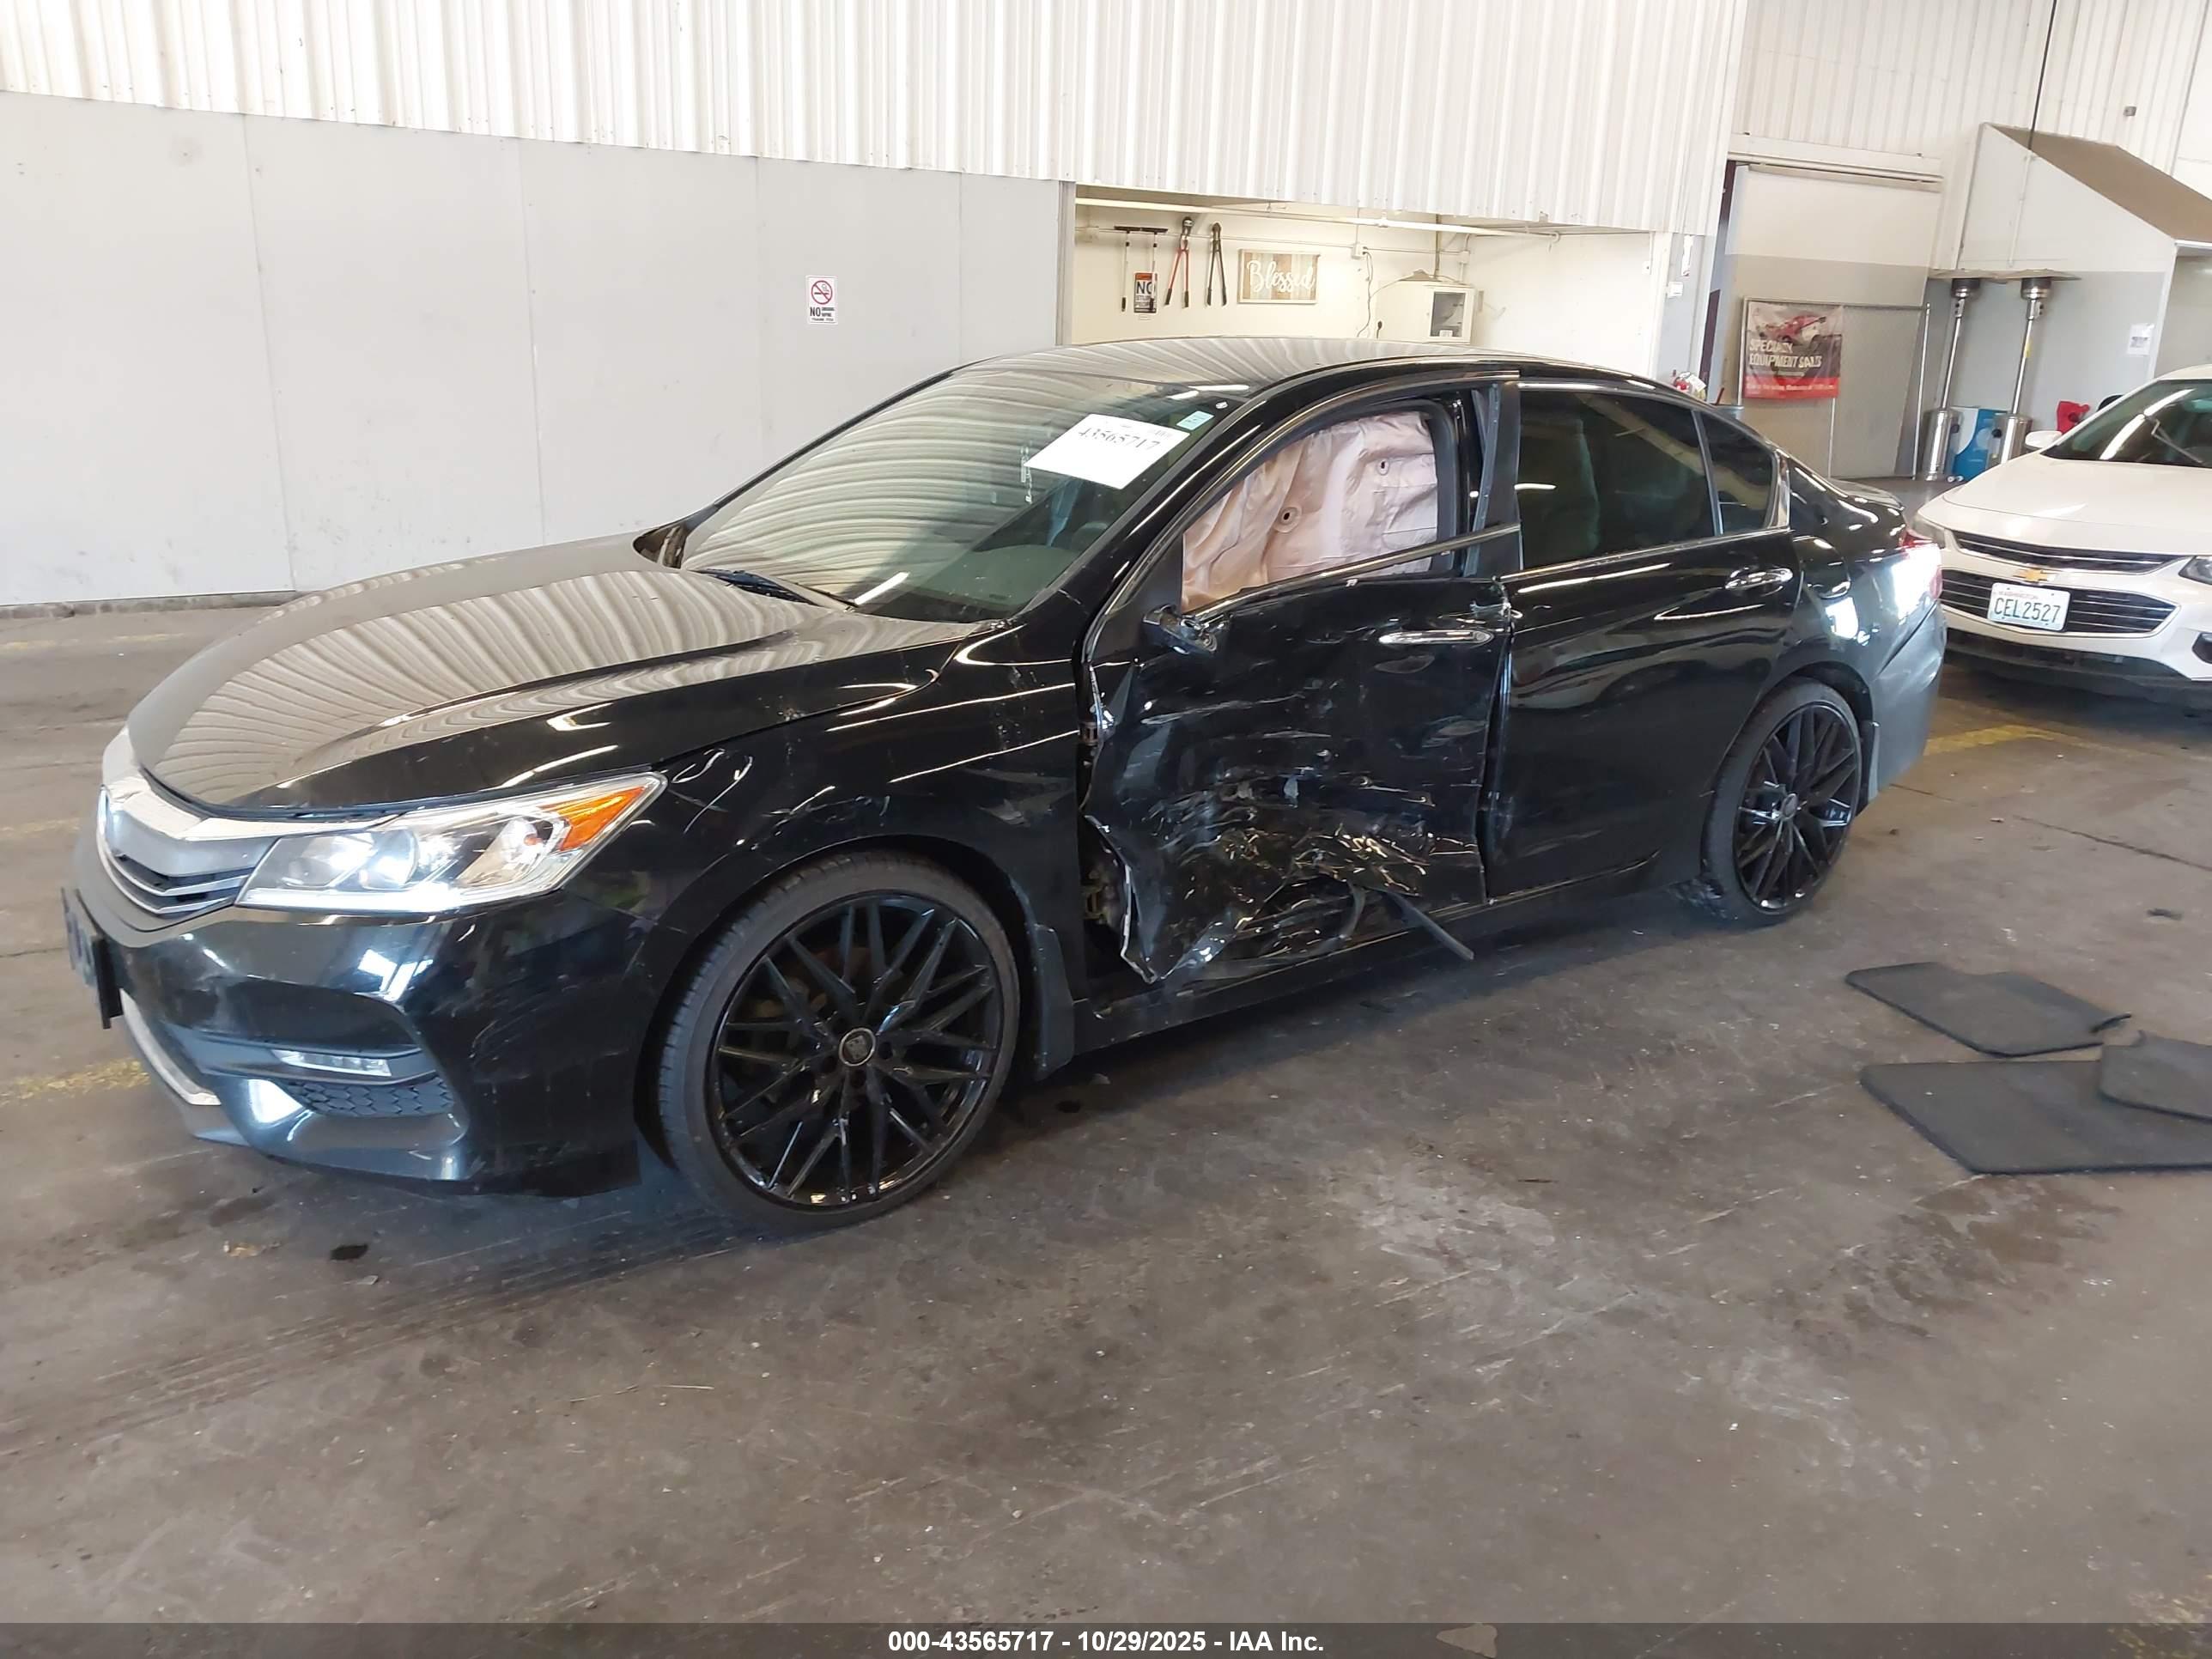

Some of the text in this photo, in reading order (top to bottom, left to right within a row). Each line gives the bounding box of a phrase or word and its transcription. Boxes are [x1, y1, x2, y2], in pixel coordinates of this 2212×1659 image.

[1247, 259, 1316, 293] Blessed
[810, 307, 821, 317] NO
[1994, 598, 2061, 623] CEL2527
